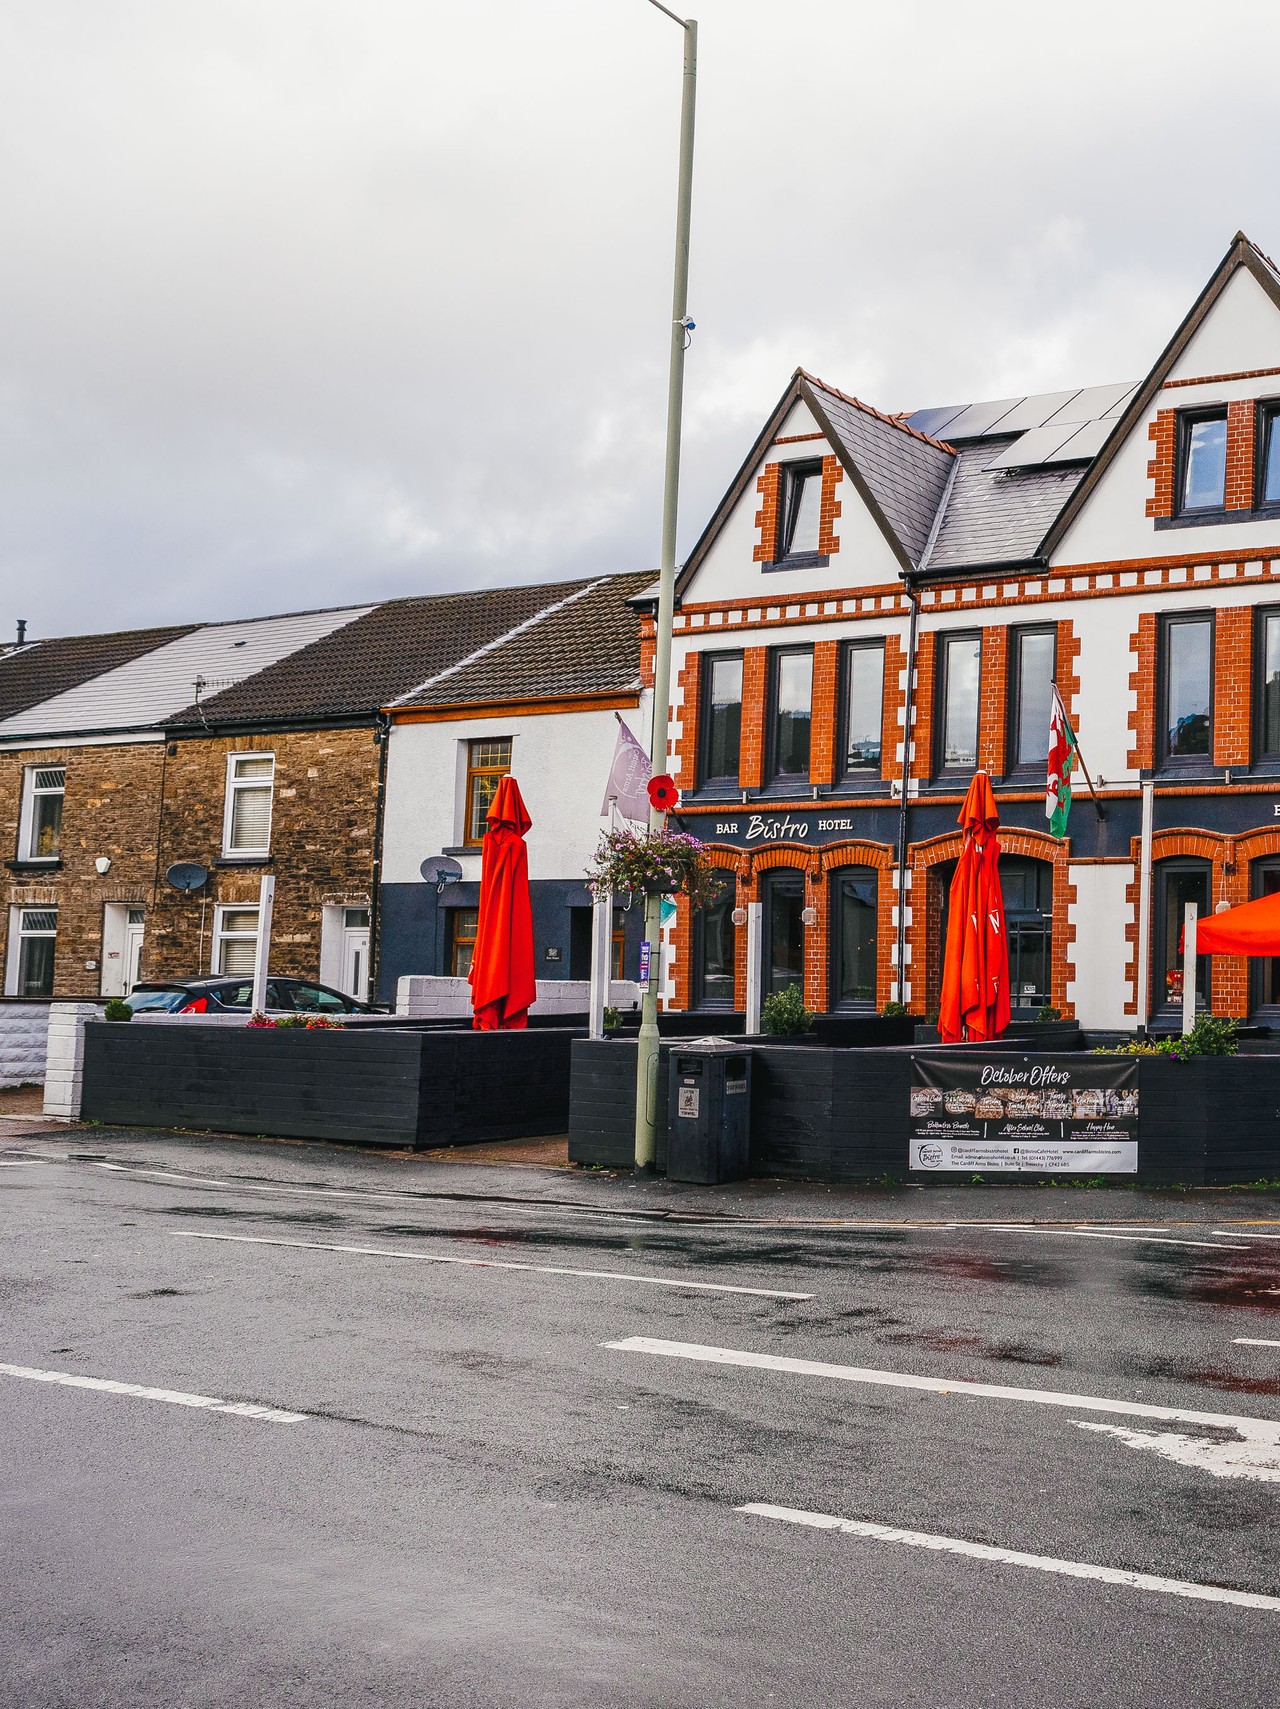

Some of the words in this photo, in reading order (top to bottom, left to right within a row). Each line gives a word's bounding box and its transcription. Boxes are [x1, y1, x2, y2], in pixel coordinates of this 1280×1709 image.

[716, 823, 738, 834] BAR
[745, 814, 809, 840] Bistro
[818, 819, 853, 830] HOTEL
[981, 1065, 1030, 1086] October
[1030, 1065, 1070, 1086] Offers
[1086, 1122, 1102, 1132] Happy
